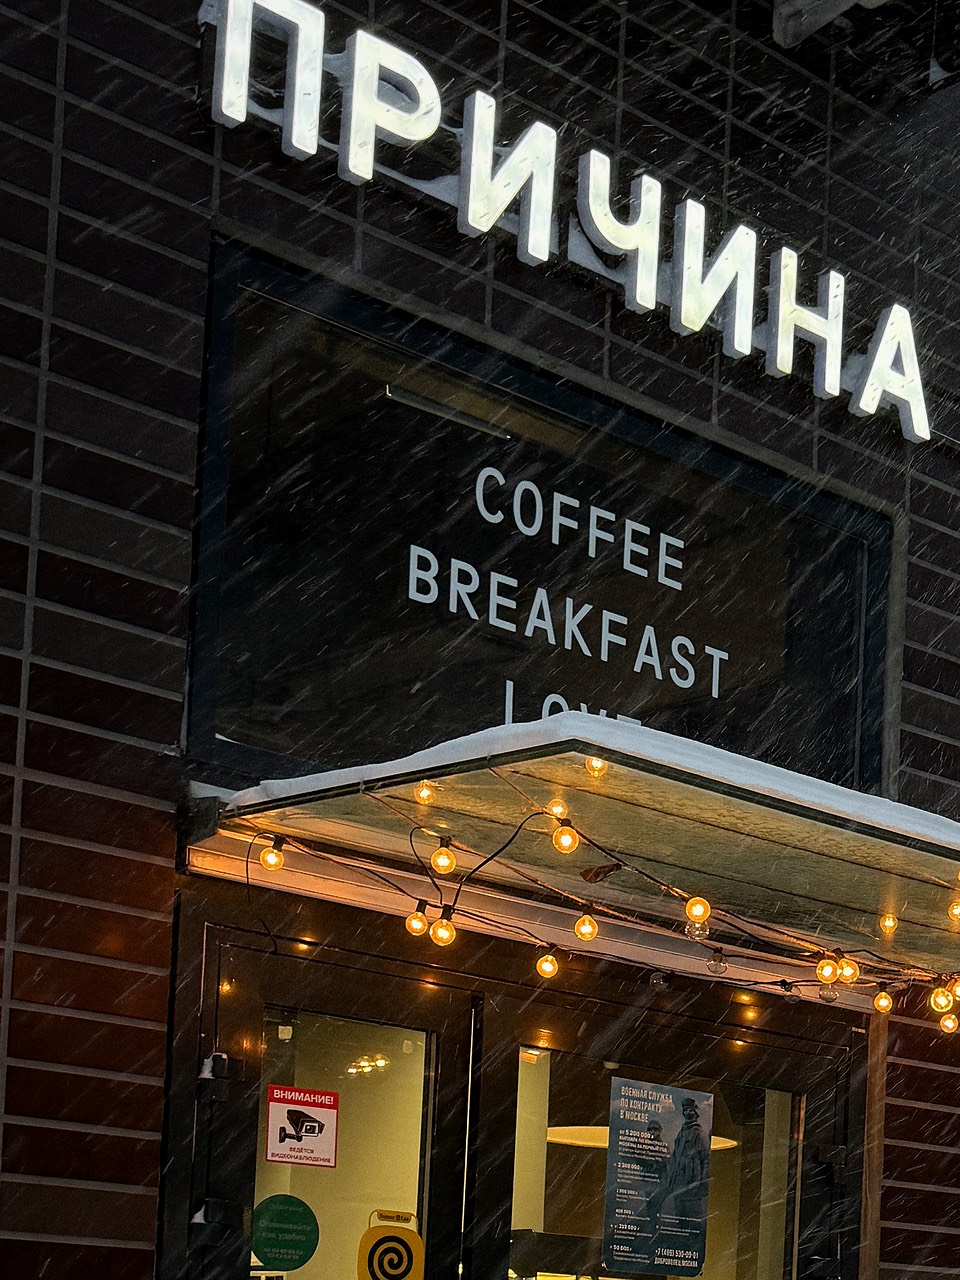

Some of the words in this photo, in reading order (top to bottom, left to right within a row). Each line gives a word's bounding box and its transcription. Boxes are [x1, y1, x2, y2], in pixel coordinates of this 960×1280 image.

[213, 0, 931, 442] ПРИЧИНА
[475, 466, 686, 592] COFFEE
[408, 544, 730, 699] BREAKFAST
[273, 1089, 334, 1105] ВНИМАНИЕ!
